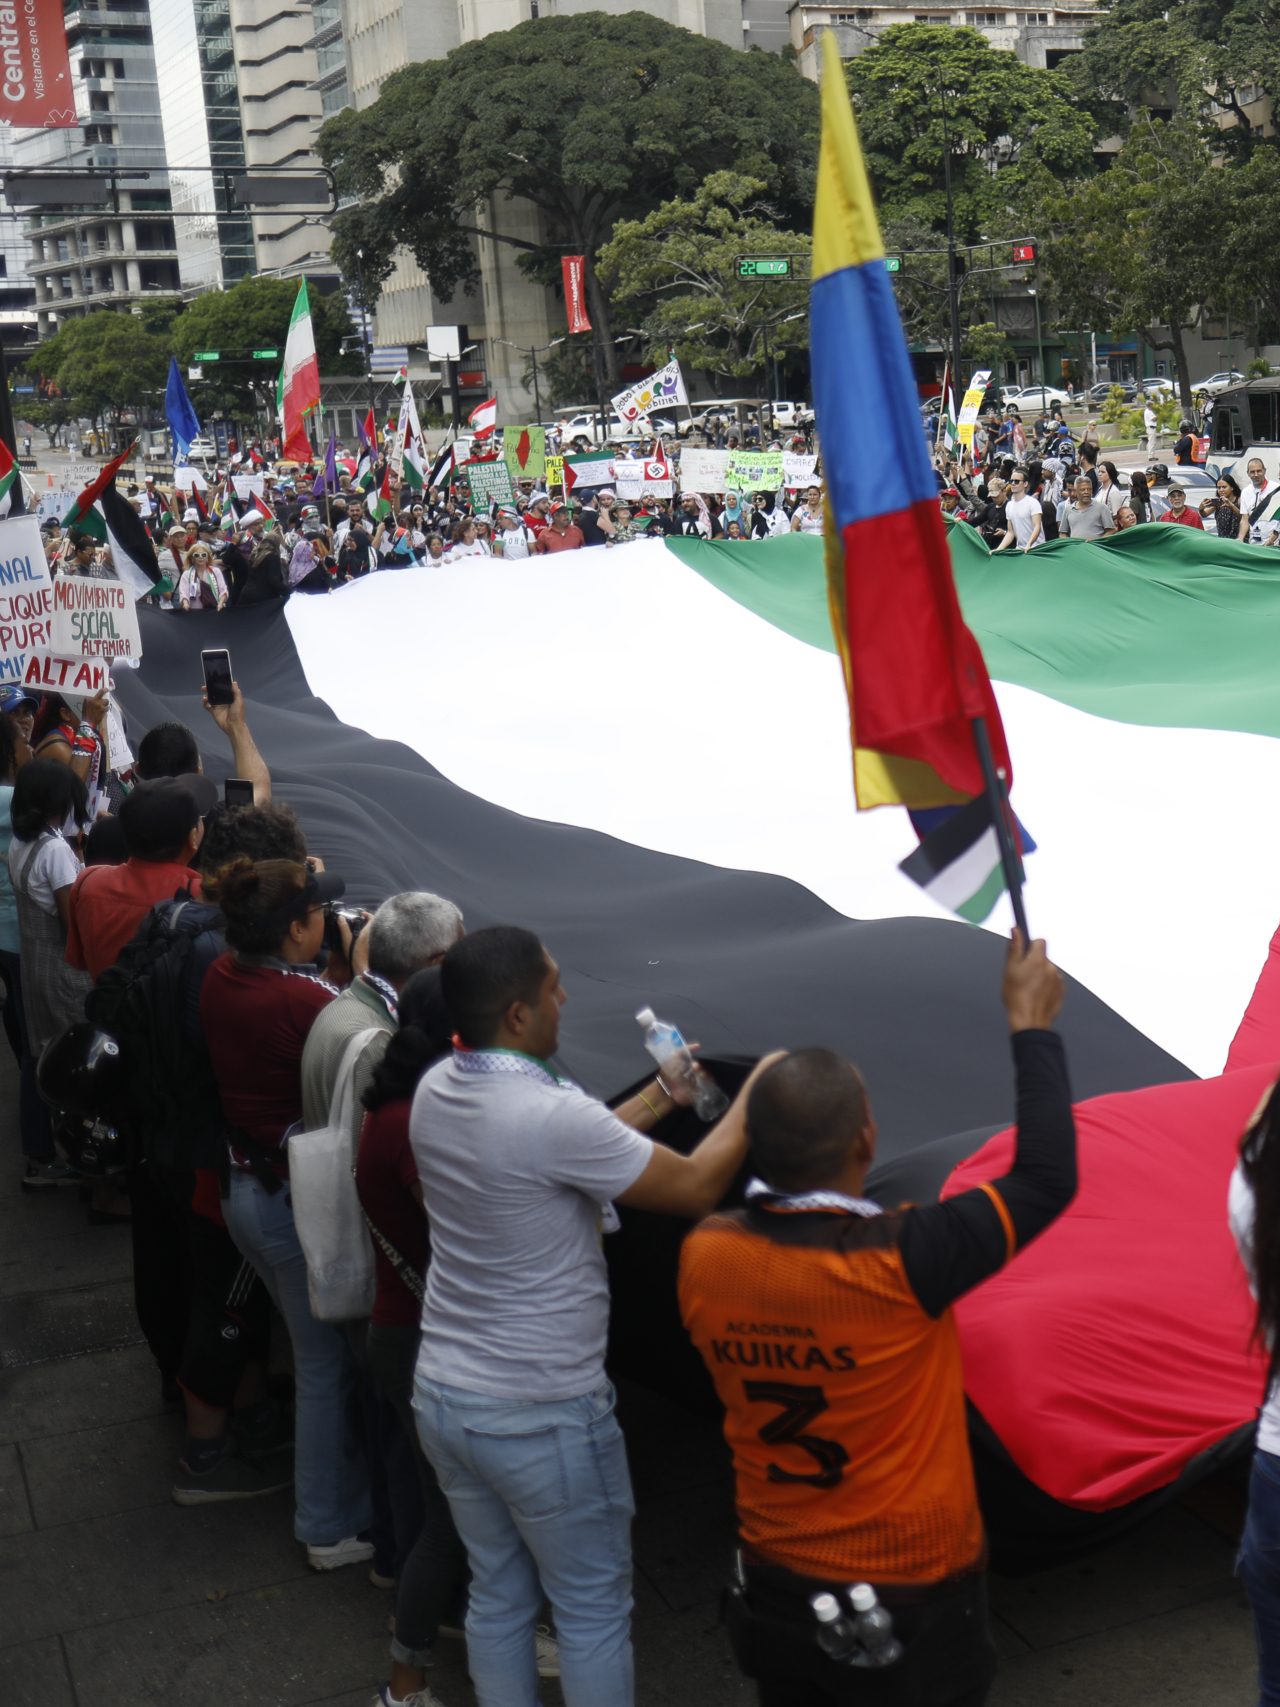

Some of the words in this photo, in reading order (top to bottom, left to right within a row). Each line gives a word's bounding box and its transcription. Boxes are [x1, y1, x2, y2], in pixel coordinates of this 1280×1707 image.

[25, 17, 36, 26] el
[29, 30, 38, 44] en
[0, 0, 25, 102] Central
[71, 609, 120, 641] SOCIAL
[81, 638, 131, 657] ALTAMIRA
[725, 1321, 816, 1339] ACADEMIA
[710, 1338, 857, 1373] KUIKAS
[741, 1379, 851, 1490] 3
